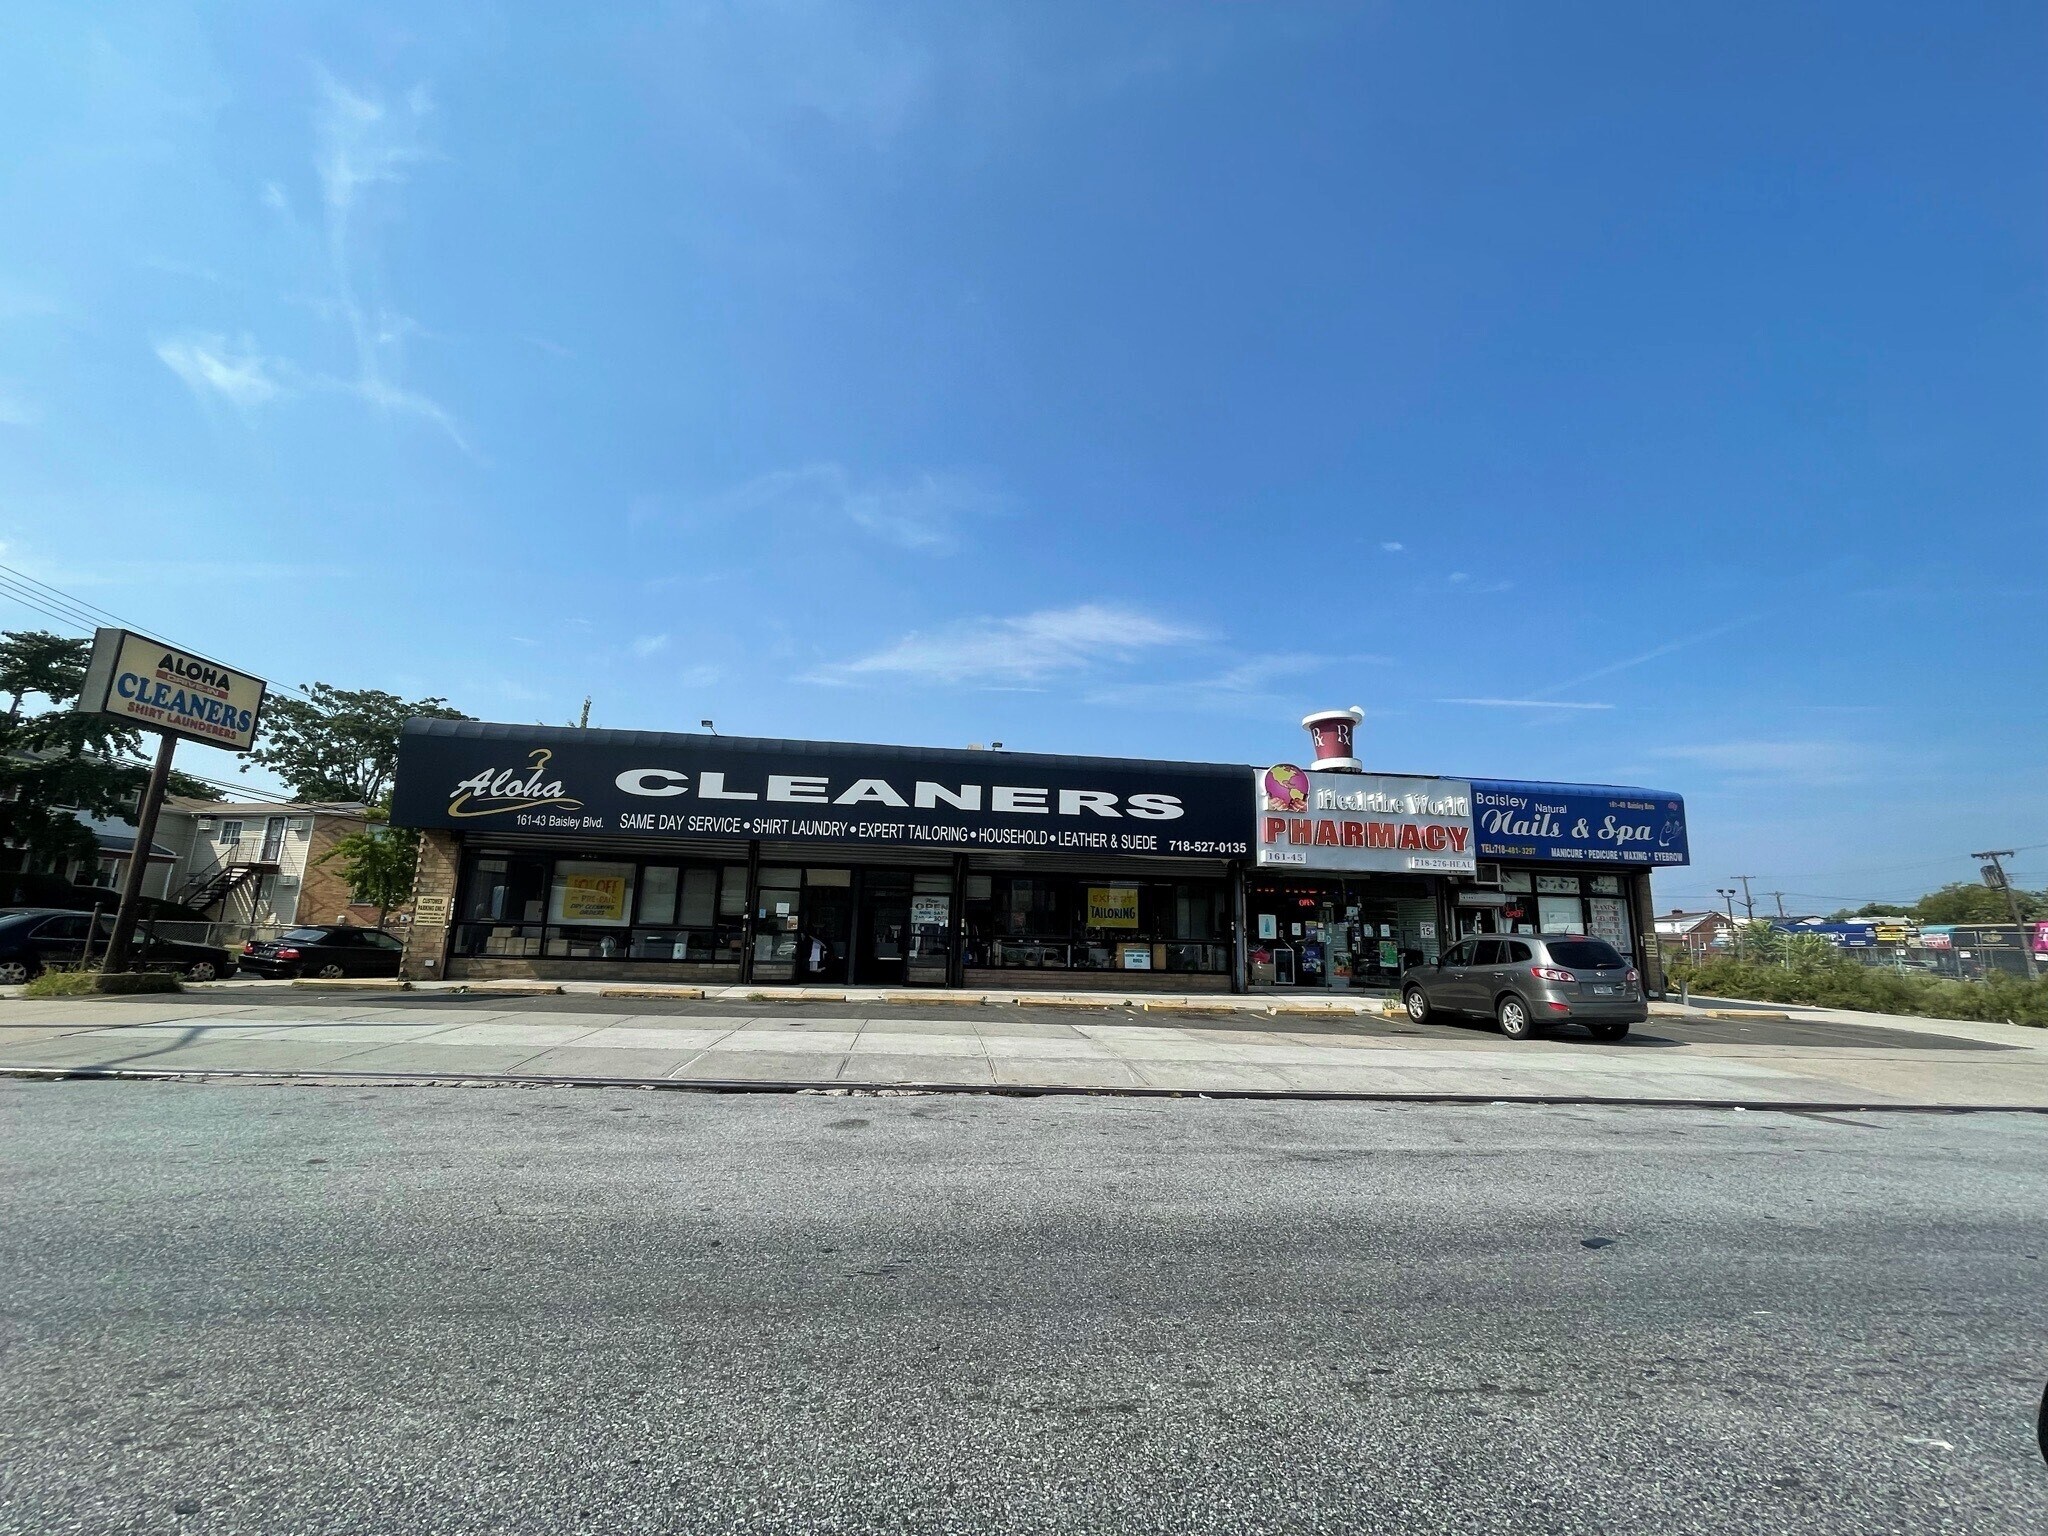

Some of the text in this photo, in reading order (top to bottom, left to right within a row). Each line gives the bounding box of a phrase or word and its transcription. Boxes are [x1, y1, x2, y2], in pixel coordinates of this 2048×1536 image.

[158, 653, 230, 691] ALOHA
[117, 672, 252, 732] CLEANERS
[127, 701, 237, 740] SHIRT LAUNDERERS
[449, 767, 566, 798] Aloha
[615, 768, 1185, 820] CLEANERS
[1476, 793, 1528, 810] Baisley
[1405, 793, 1470, 816] World
[1535, 803, 1567, 814] Natural
[516, 814, 604, 830] 161-43 Baisley Blvd.
[619, 813, 1158, 850] SAME DAY SERVICE SHIRT LAUNDRY EXPERT TAILORING HOUSEHOLD LEATHER & SUEDE
[1481, 809, 1654, 846] Nails & Spa
[1265, 817, 1470, 852] PHARMACY
[1169, 840, 1247, 853] 718-527-0135
[1551, 847, 1683, 862] MANICURE PEDICURE WAXING EYEBROW
[1268, 852, 1303, 862] 161-45
[1414, 859, 1473, 868] 718-276-HEAL
[915, 903, 948, 911] OPEN
[1090, 905, 1136, 919] TAILORING
